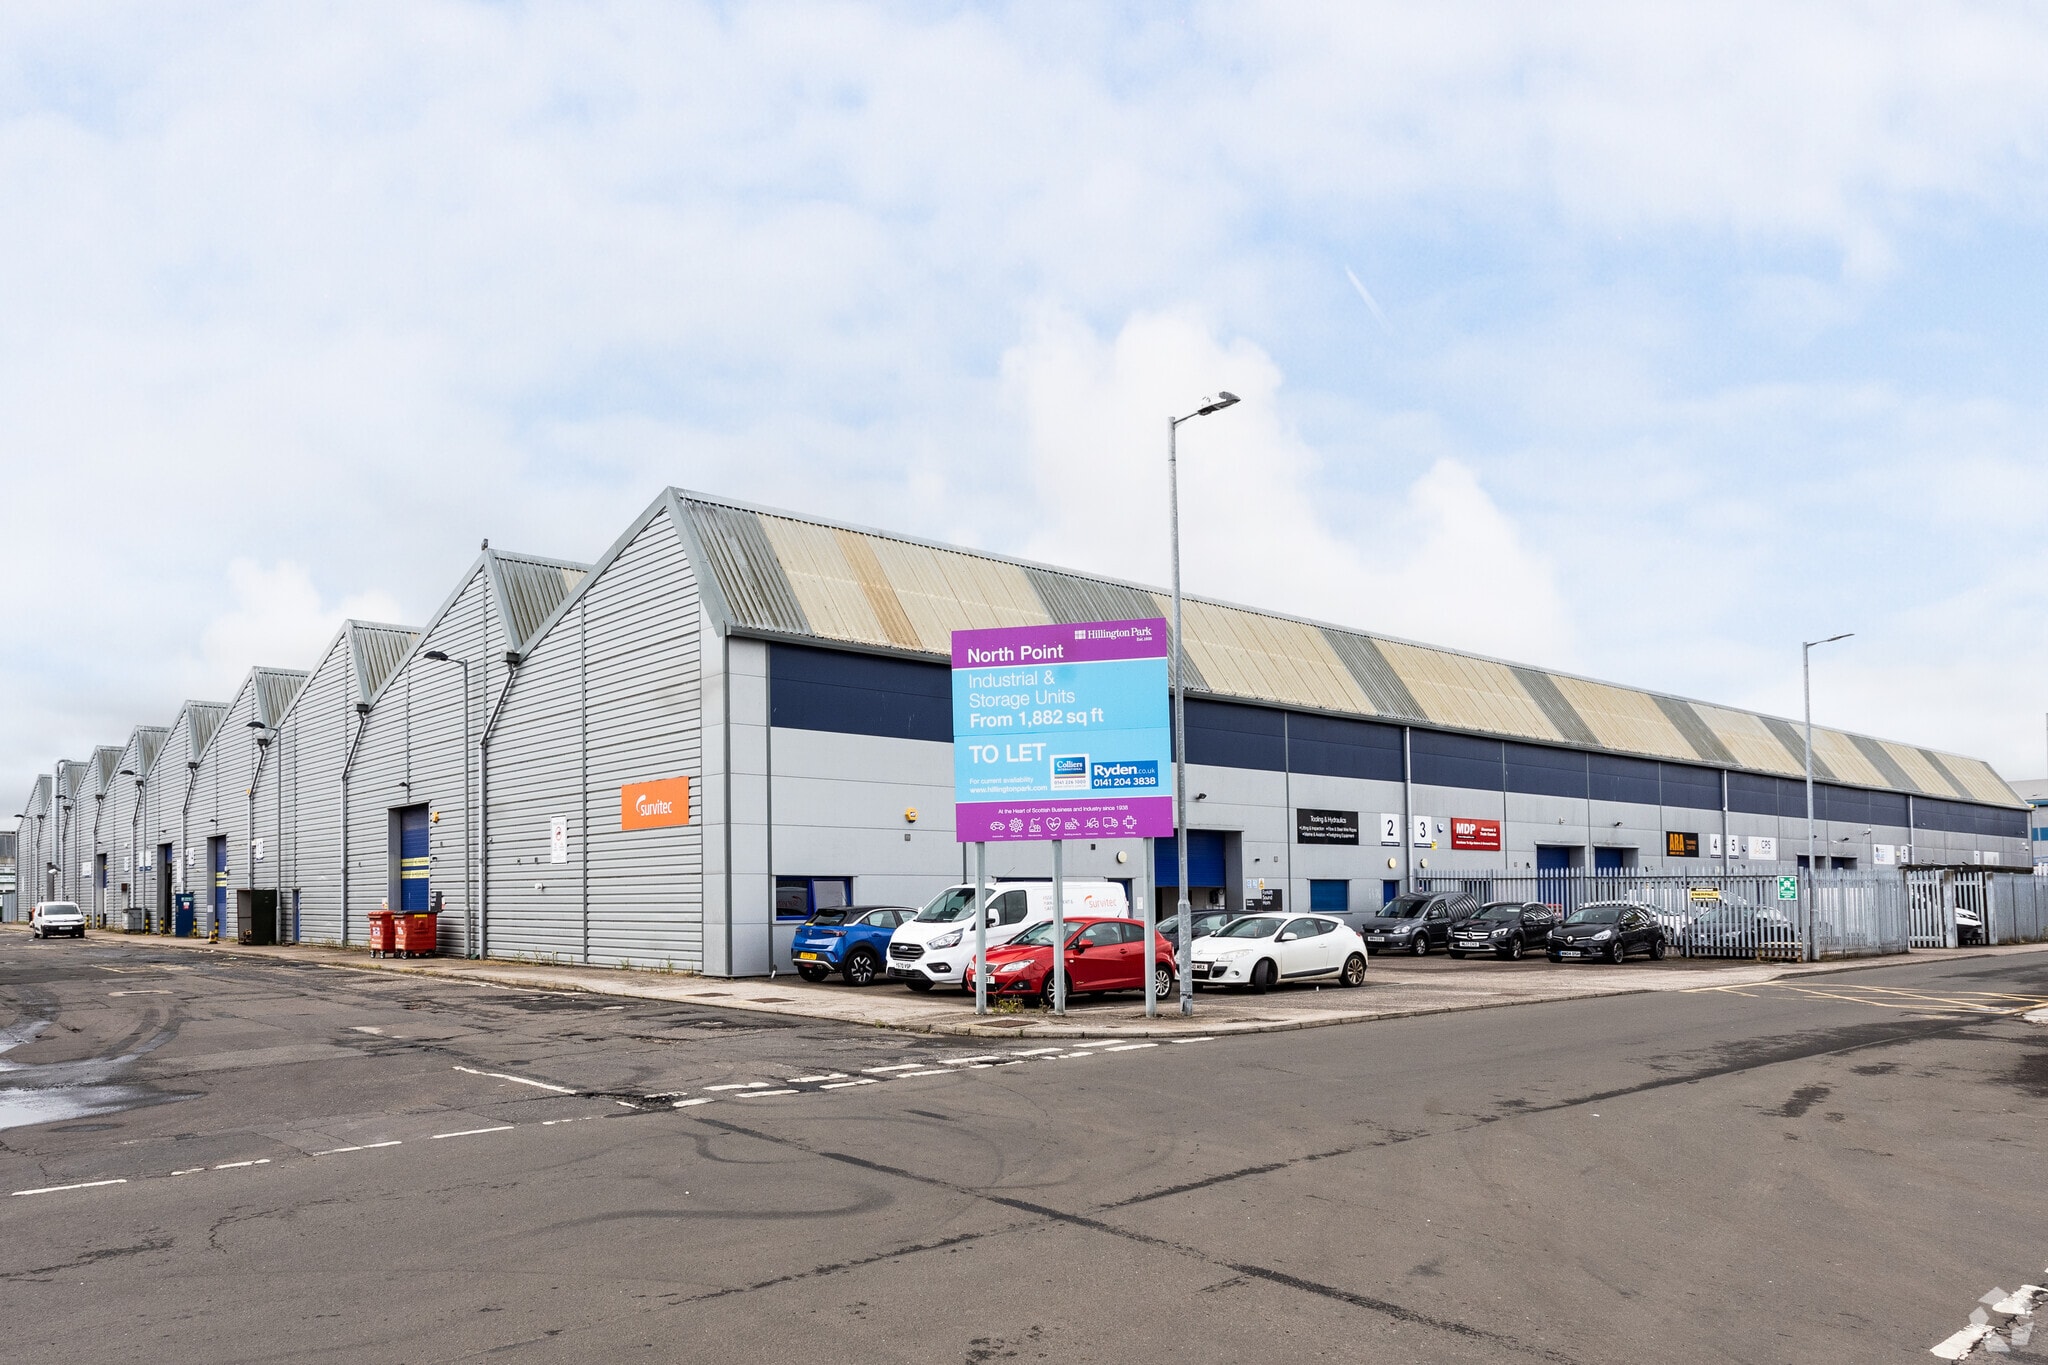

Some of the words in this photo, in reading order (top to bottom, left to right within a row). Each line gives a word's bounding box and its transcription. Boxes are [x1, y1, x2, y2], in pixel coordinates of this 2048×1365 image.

[1087, 629, 1130, 640] Hillington
[1131, 626, 1152, 637] Park
[967, 646, 1014, 664] North
[1020, 644, 1064, 660] Point
[968, 671, 1038, 688] Industrial
[1043, 670, 1055, 685] &
[969, 692, 1030, 710] Storage
[1035, 689, 1076, 705] Units
[970, 712, 1013, 728] From
[1018, 709, 1063, 728] 1,882
[1066, 712, 1087, 726] sq
[1090, 708, 1104, 722] ft
[968, 744, 999, 764] TO
[1006, 743, 1046, 762] LET
[1056, 760, 1083, 768] Colliers
[1093, 778, 1112, 786] 0141
[1114, 778, 1132, 786] 204
[1133, 776, 1156, 786] 3838
[970, 785, 1048, 794] www.hillingtonpark.com
[640, 800, 673, 816] survitec
[1310, 815, 1324, 824] Tooling
[1387, 820, 1394, 836] 2
[1420, 822, 1426, 838] 3
[1456, 823, 1476, 834] MDP
[1669, 834, 1685, 850] ARA
[1713, 838, 1717, 851] 4
[1732, 840, 1736, 851] 5
[1761, 840, 1771, 849] CPS
[1088, 898, 1117, 908] survitec
